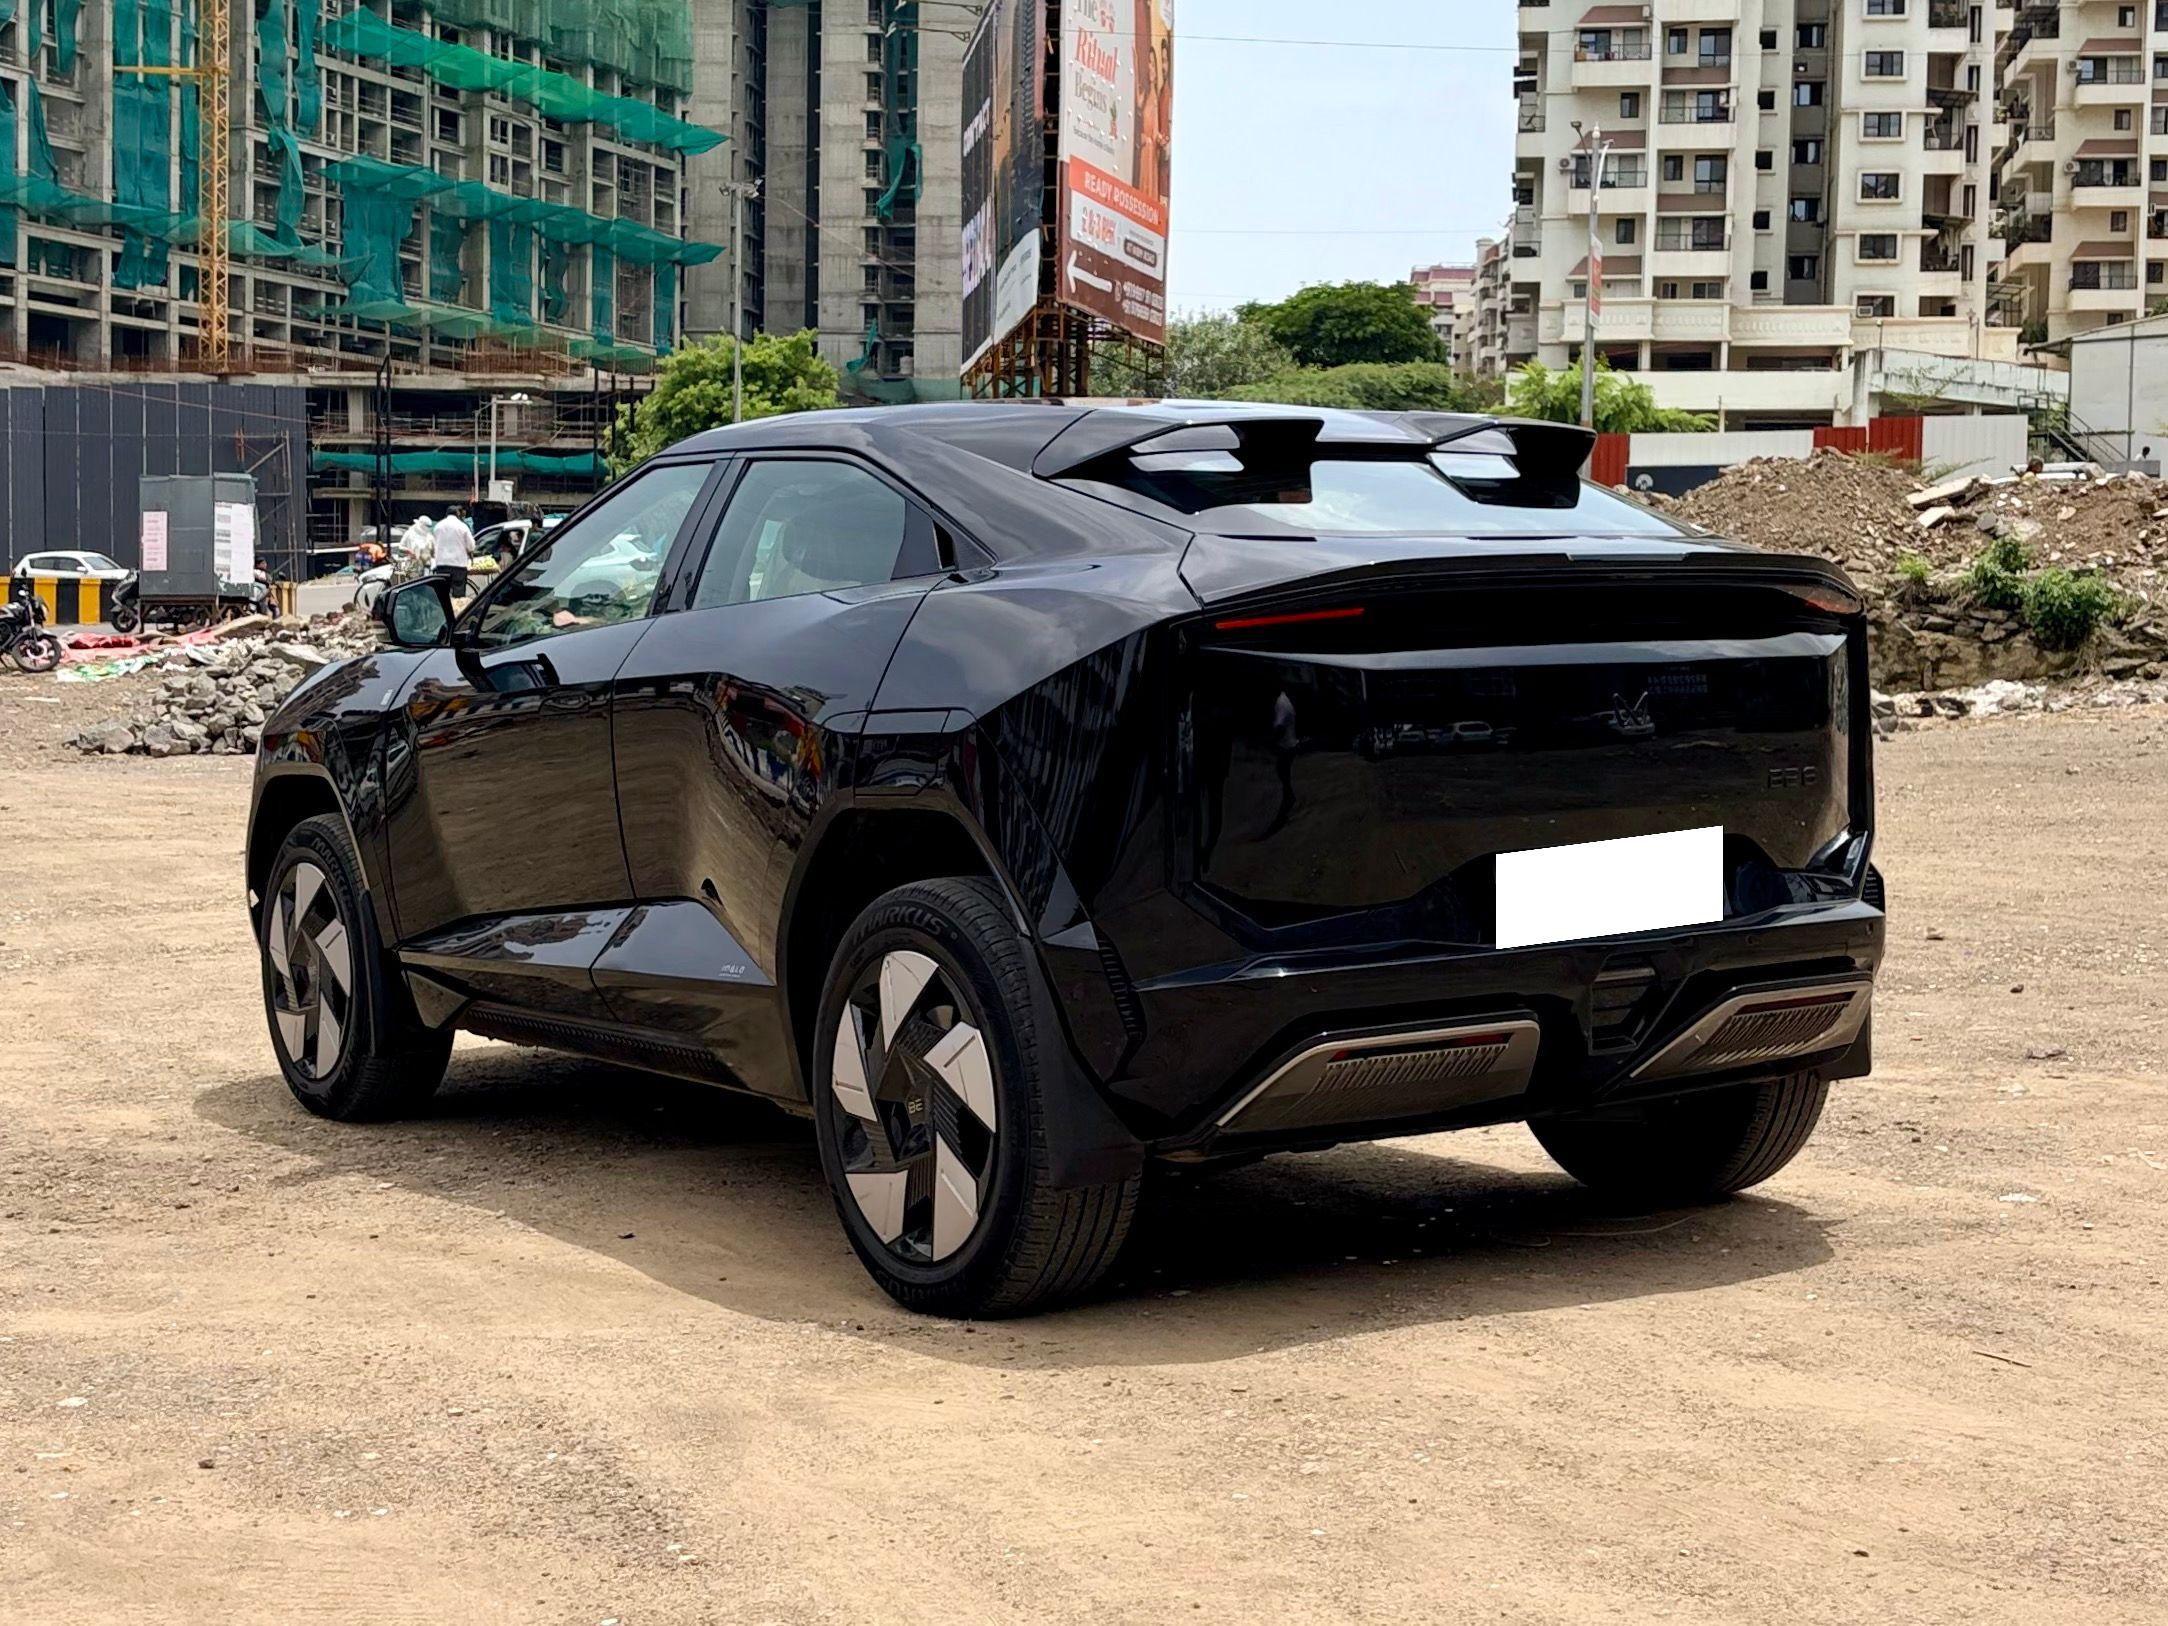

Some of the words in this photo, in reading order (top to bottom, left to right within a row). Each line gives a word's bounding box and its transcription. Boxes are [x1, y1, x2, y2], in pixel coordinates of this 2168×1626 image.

[1075, 25, 1118, 83] Ritual
[1075, 71, 1109, 114] Begins
[1084, 171, 1112, 201] READY
[1113, 186, 1160, 225] POSSESSION
